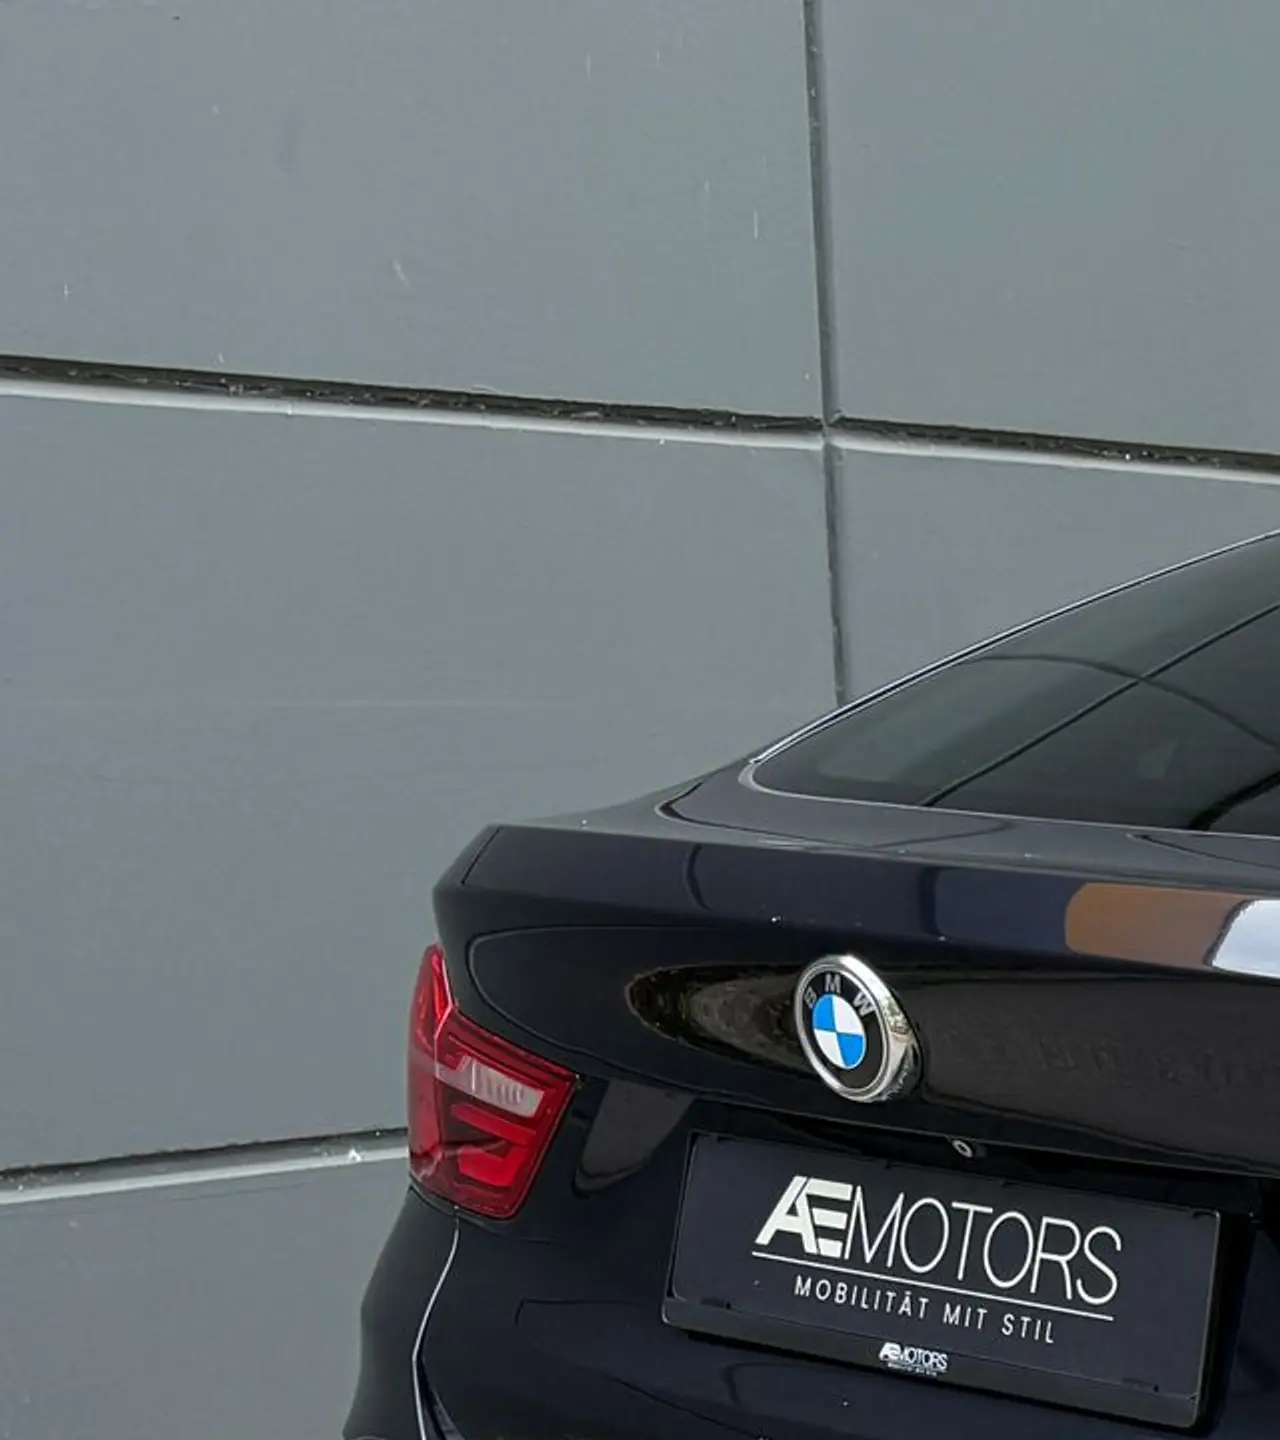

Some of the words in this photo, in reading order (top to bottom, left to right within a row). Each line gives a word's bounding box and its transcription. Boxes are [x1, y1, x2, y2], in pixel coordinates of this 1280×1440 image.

[803, 973, 876, 1017] BMW
[794, 1274, 929, 1319] MOBILITÄT
[942, 1302, 988, 1330] MIT
[1001, 1313, 1054, 1344] STIL
